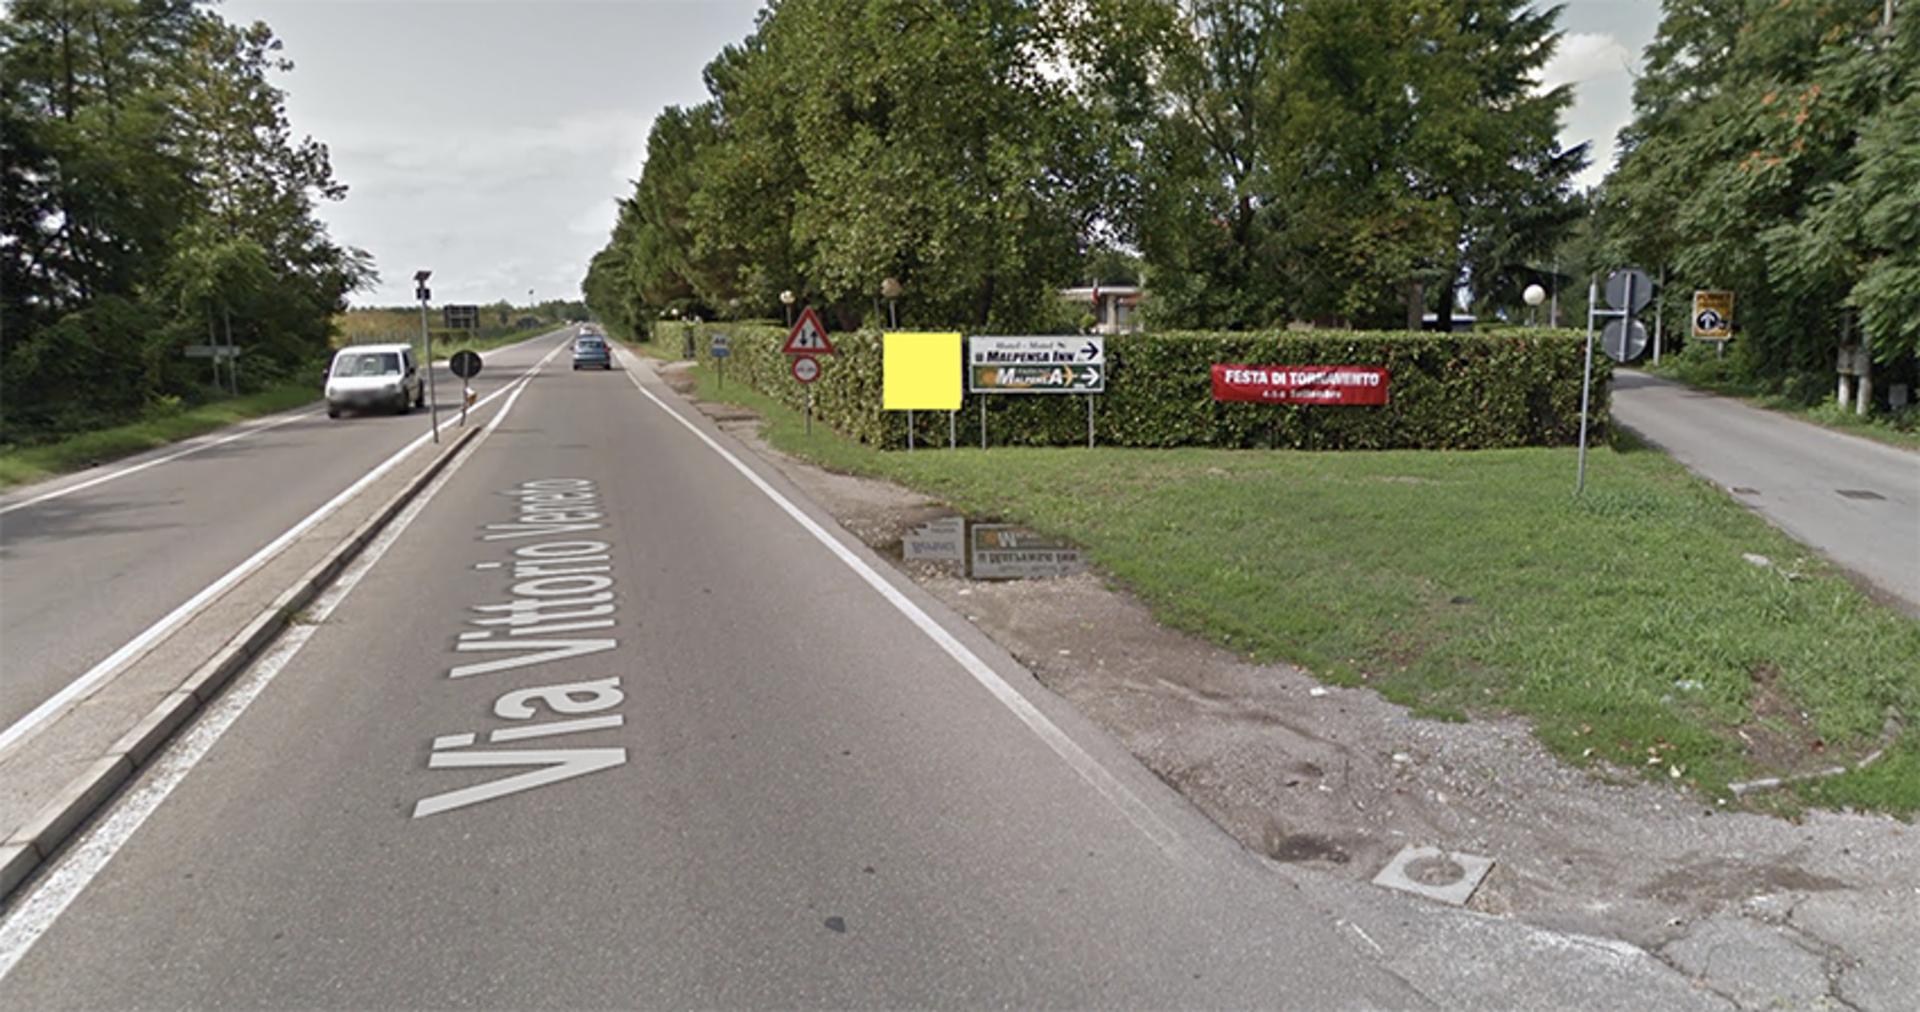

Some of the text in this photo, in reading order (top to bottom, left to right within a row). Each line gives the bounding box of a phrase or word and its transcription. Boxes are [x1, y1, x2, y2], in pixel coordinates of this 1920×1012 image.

[1052, 351, 1075, 362] INN
[1225, 370, 1268, 384] FESTA
[1271, 372, 1286, 385] DI
